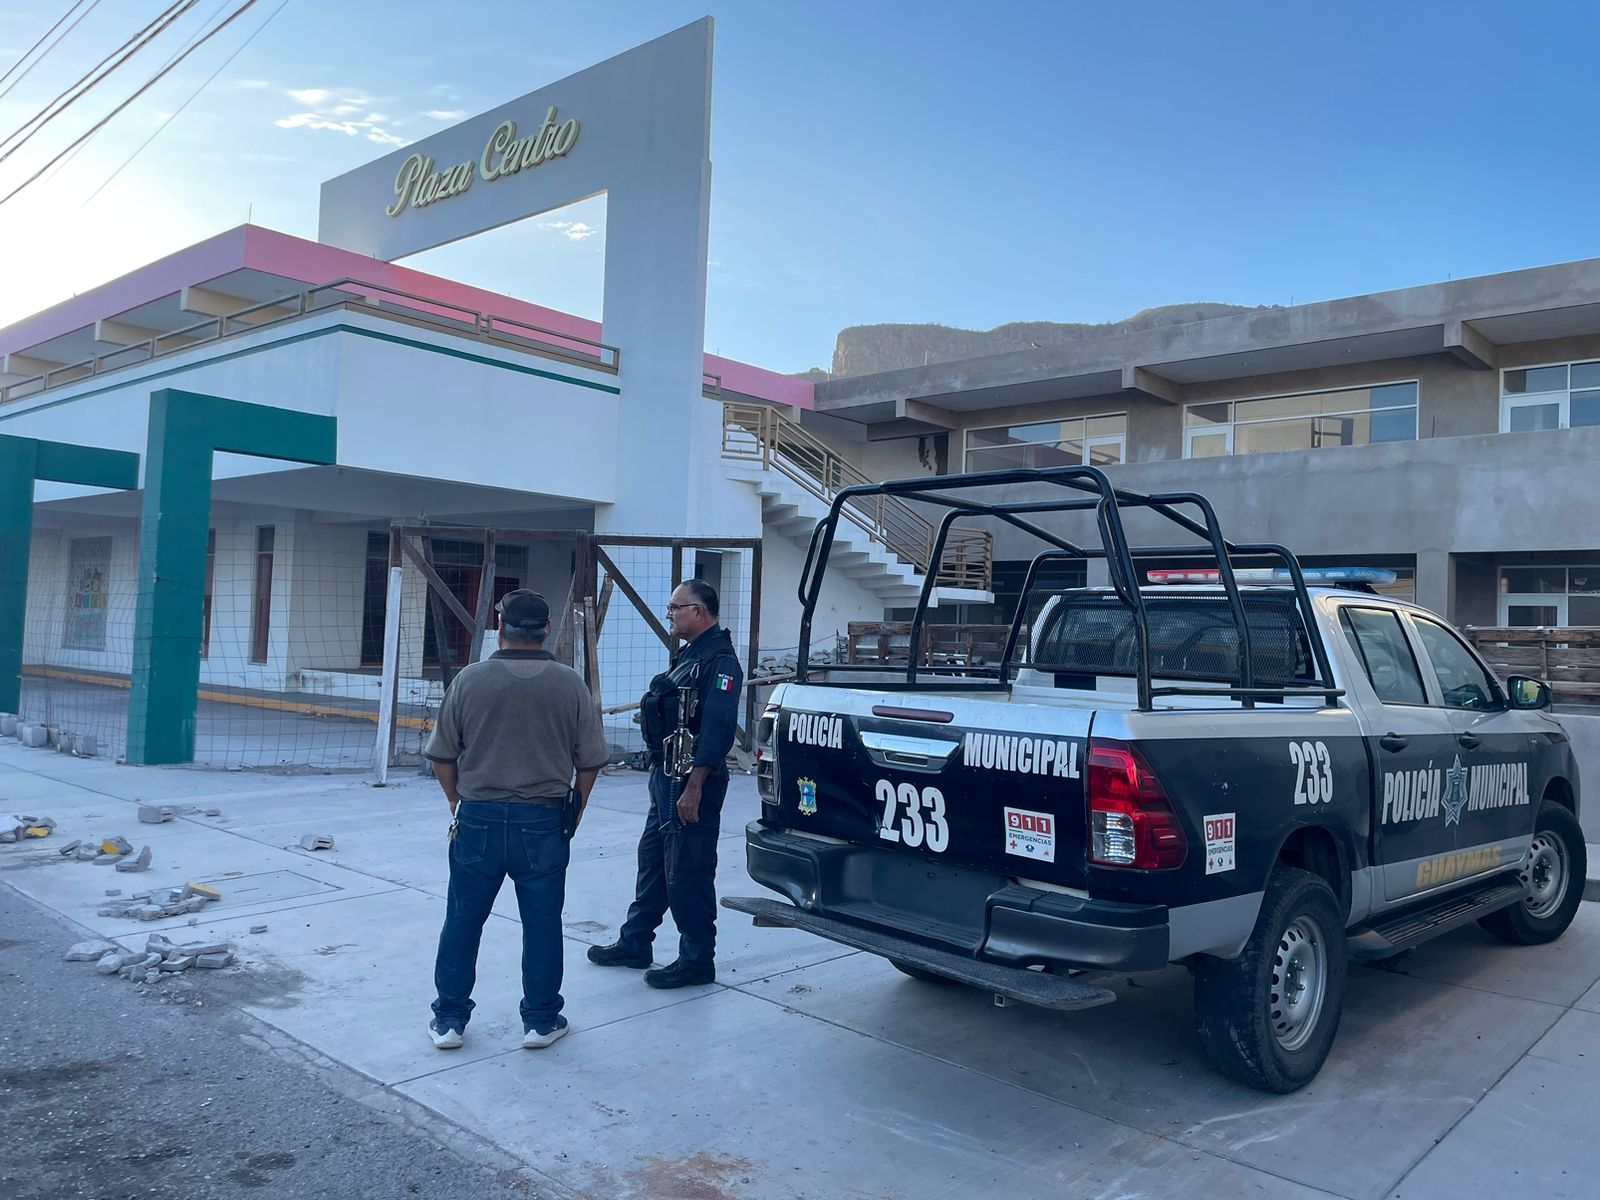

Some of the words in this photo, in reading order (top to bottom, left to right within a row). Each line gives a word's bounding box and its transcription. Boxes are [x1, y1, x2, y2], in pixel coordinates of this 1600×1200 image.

[386, 153, 475, 217] Plaza
[480, 105, 580, 181] Centro
[788, 712, 843, 749] POLICÍA
[963, 732, 1080, 779] MUNICIPAL
[1289, 741, 1334, 805] 233
[875, 778, 950, 853] 233
[1010, 814, 1047, 832] 911
[1381, 760, 1440, 825] POLICÍA
[1467, 762, 1530, 811] MUNICIPAL
[1008, 832, 1052, 846] EMERGENCIAS
[1207, 821, 1231, 839] 911
[1415, 845, 1503, 889] GUAYMAS
